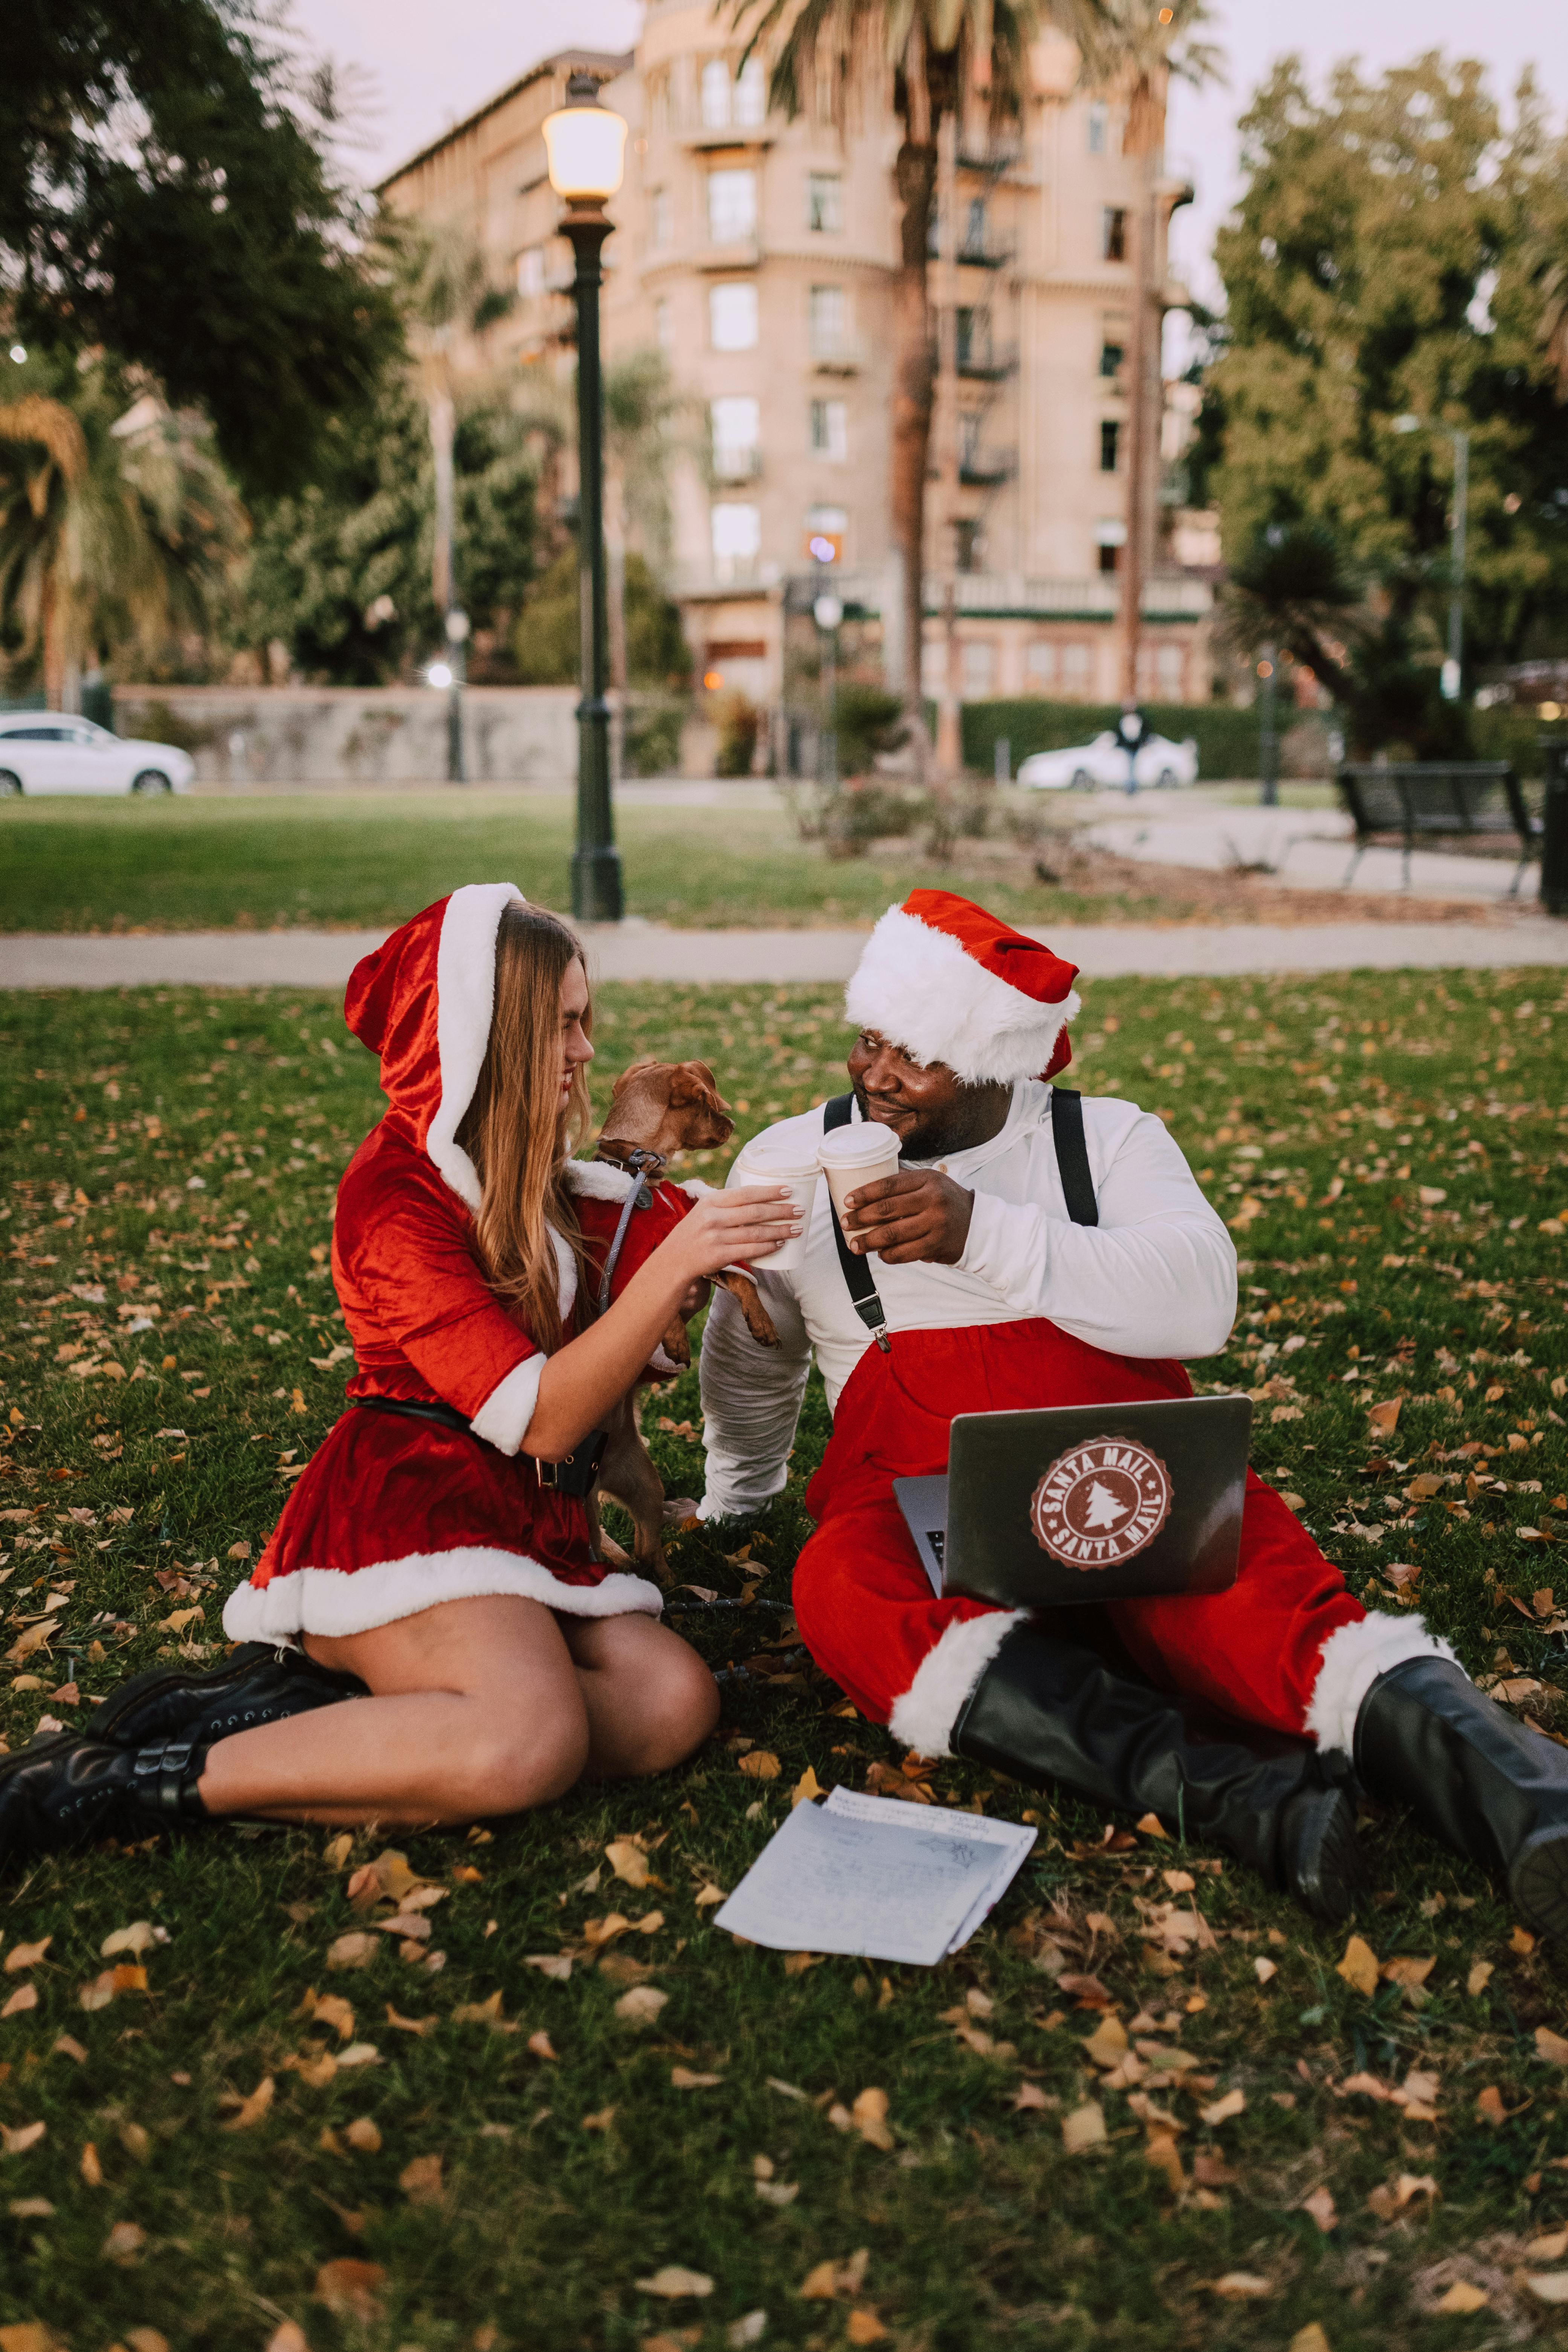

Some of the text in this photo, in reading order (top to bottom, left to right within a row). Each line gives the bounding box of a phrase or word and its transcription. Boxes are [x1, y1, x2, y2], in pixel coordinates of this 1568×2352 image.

[1043, 1447, 1150, 1513] SANTA MAIL
[1052, 1494, 1161, 1559] SANTA MAIL
